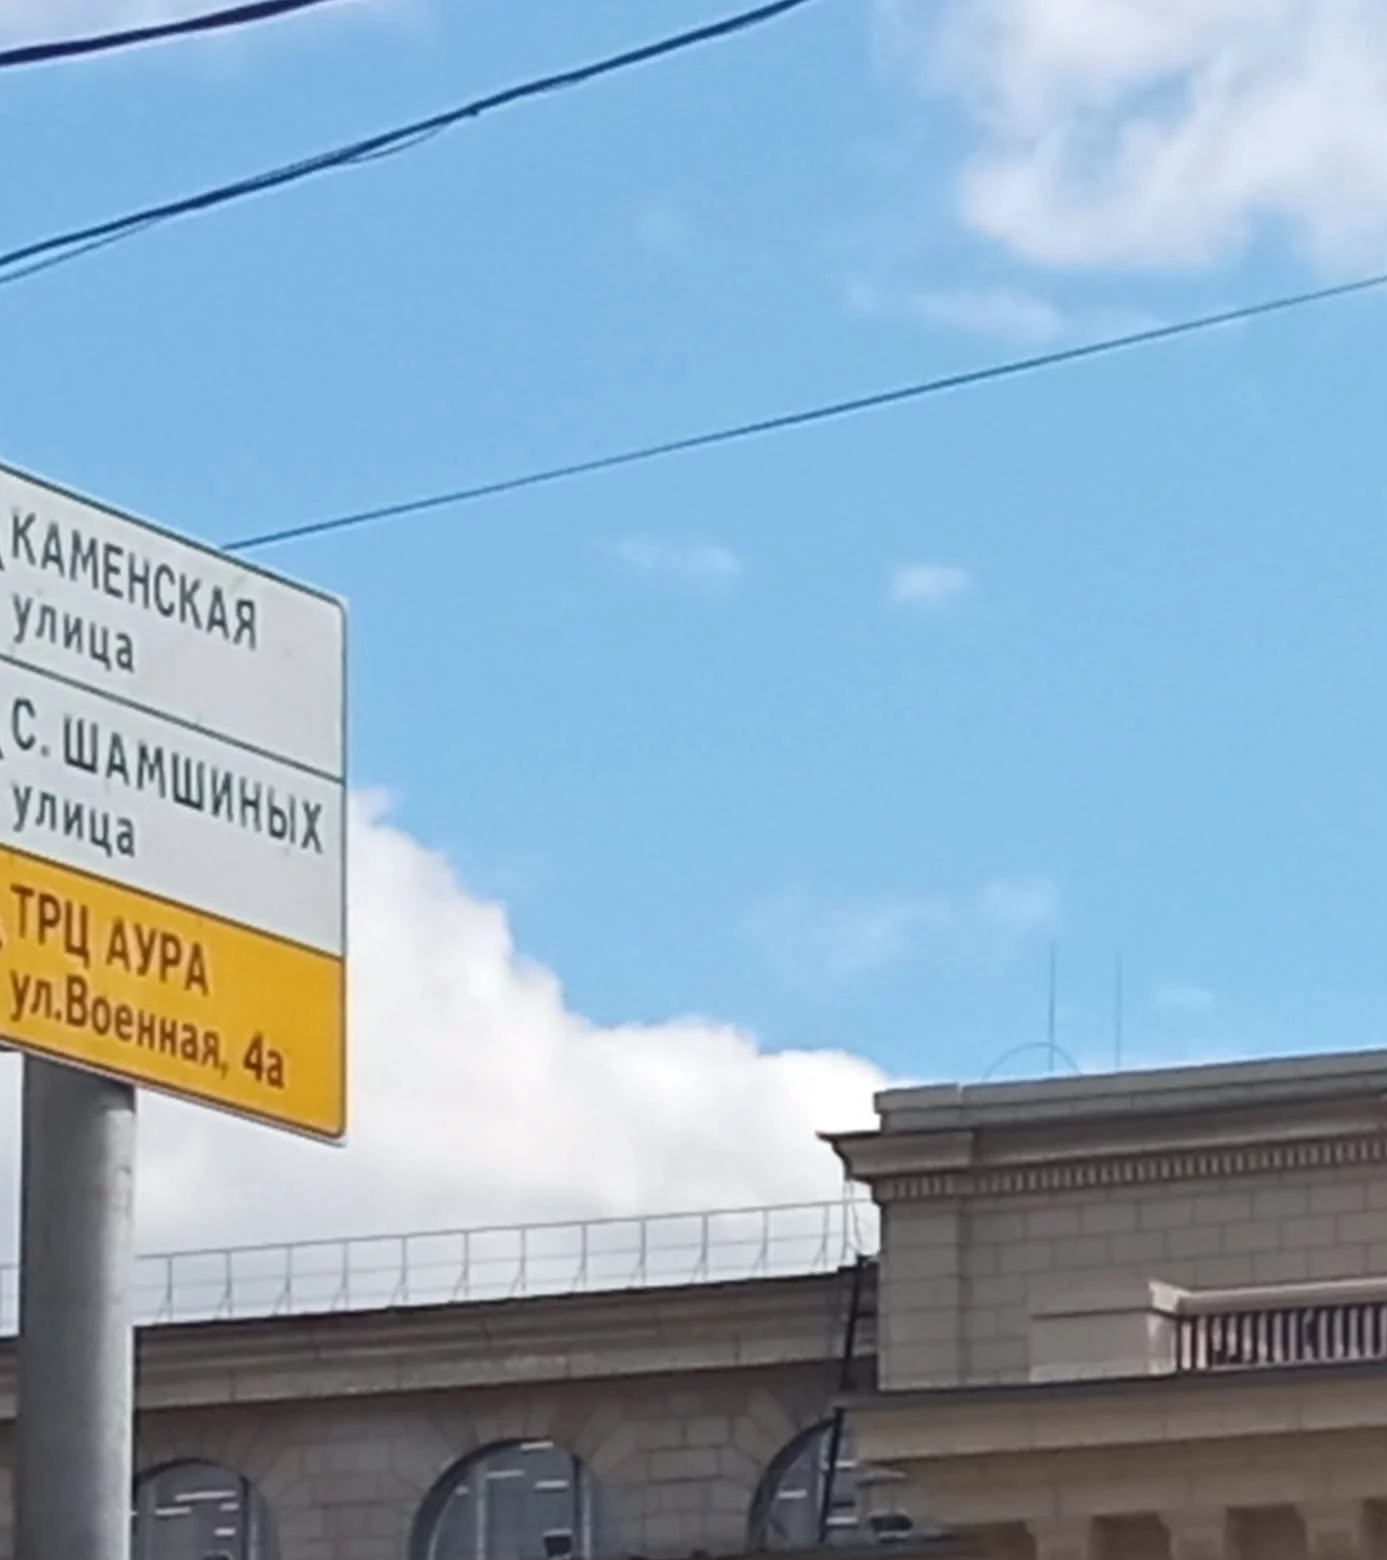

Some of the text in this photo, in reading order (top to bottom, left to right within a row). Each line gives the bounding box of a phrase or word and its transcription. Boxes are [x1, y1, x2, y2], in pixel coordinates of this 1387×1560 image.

[11, 511, 257, 651] КАМЕНСКАЯ
[12, 594, 135, 674] улица
[11, 697, 323, 855] С. ШАМШИНЫХ
[12, 784, 136, 858] улица
[10, 883, 209, 998] ТРЦ АУРА
[243, 1031, 286, 1089] 4а
